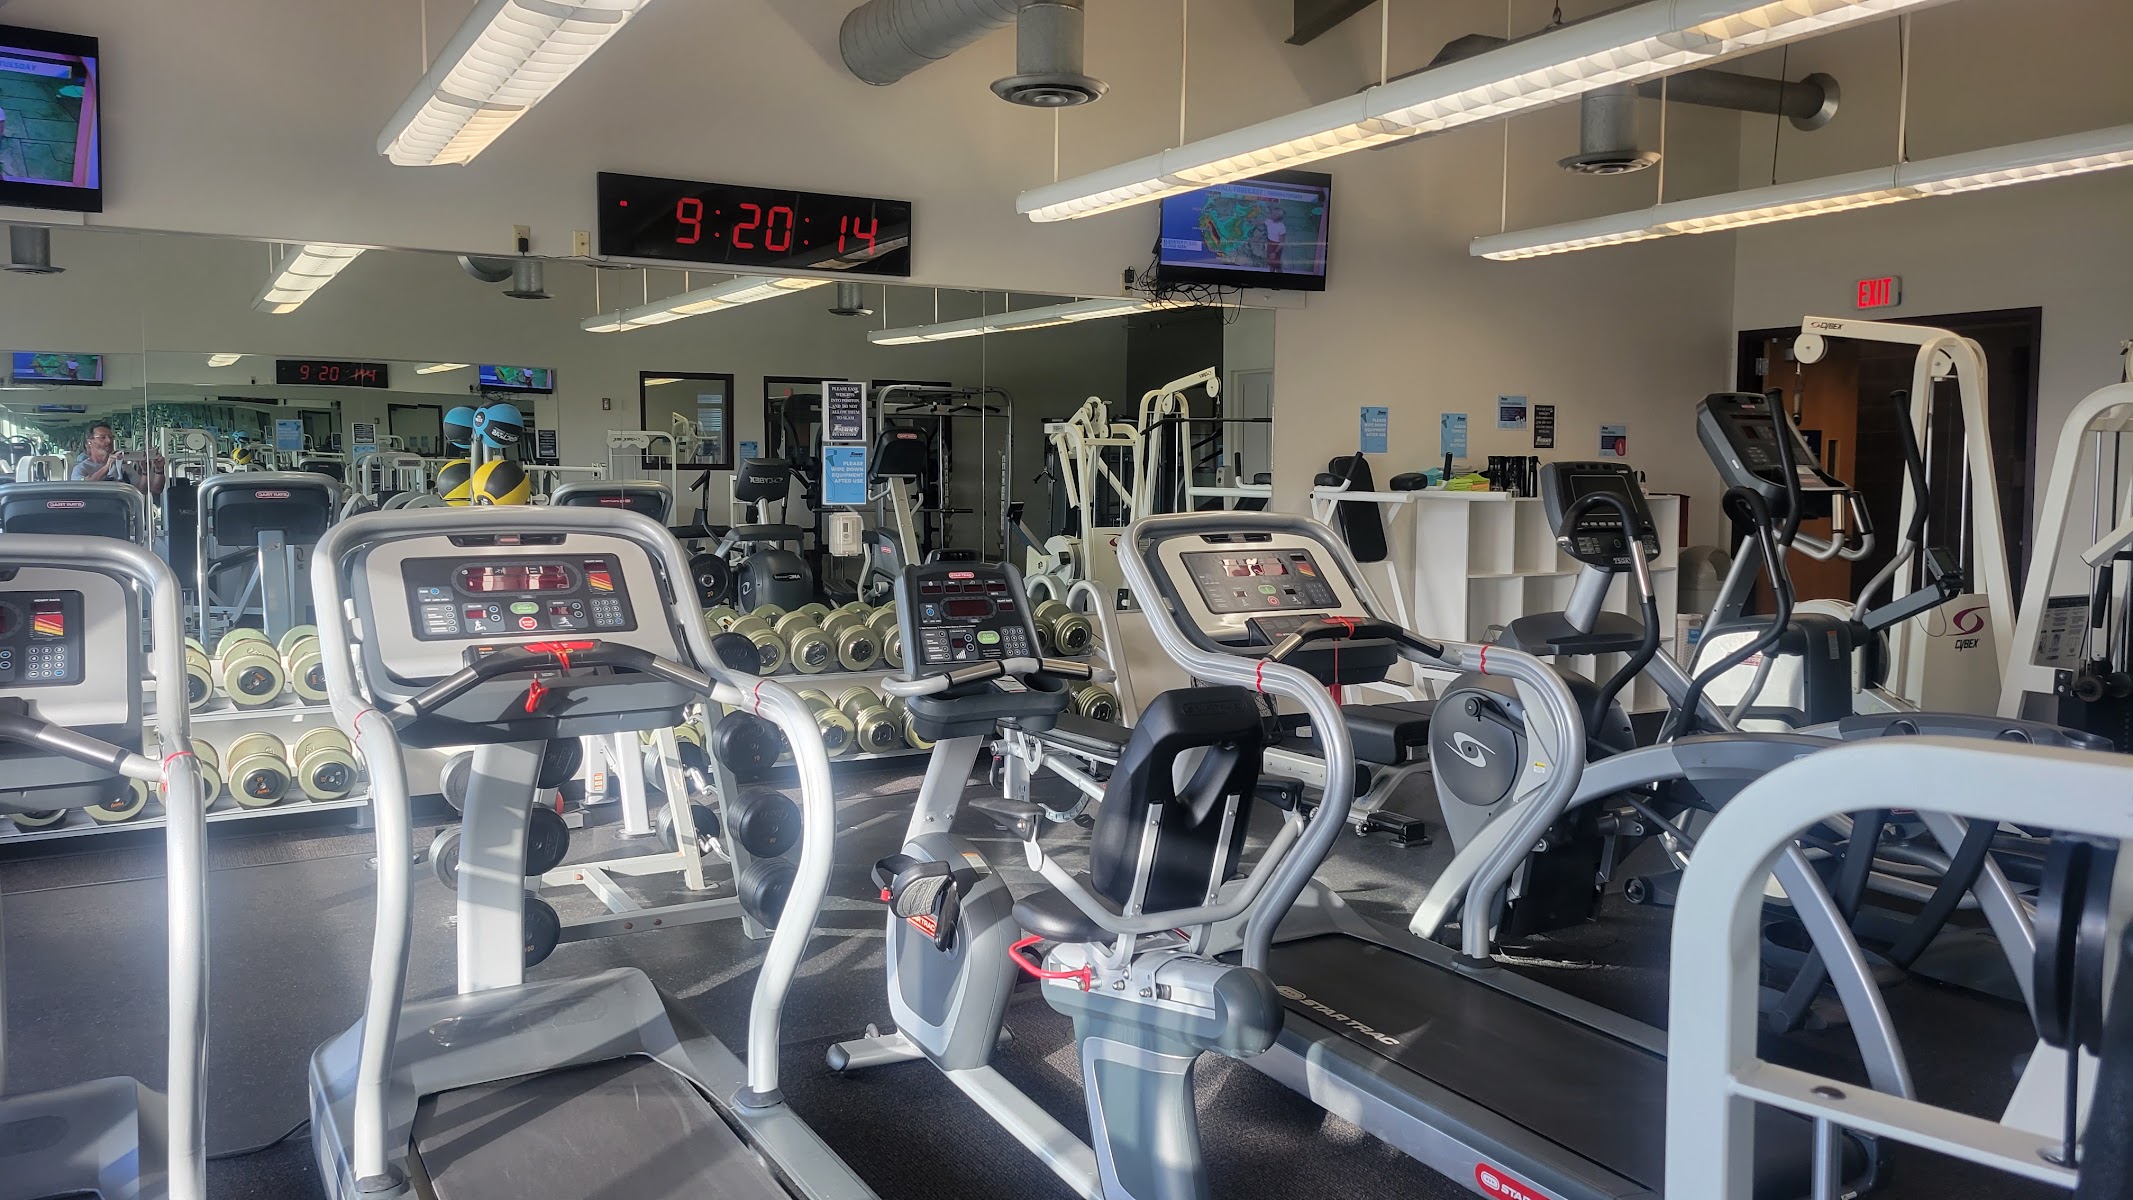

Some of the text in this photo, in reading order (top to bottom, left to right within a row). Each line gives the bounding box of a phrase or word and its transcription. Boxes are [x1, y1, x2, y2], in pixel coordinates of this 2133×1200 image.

[1858, 277, 1892, 308] EXIT
[1954, 638, 1979, 652] CYBEX
[1299, 999, 1400, 1045] STAR TRAC
